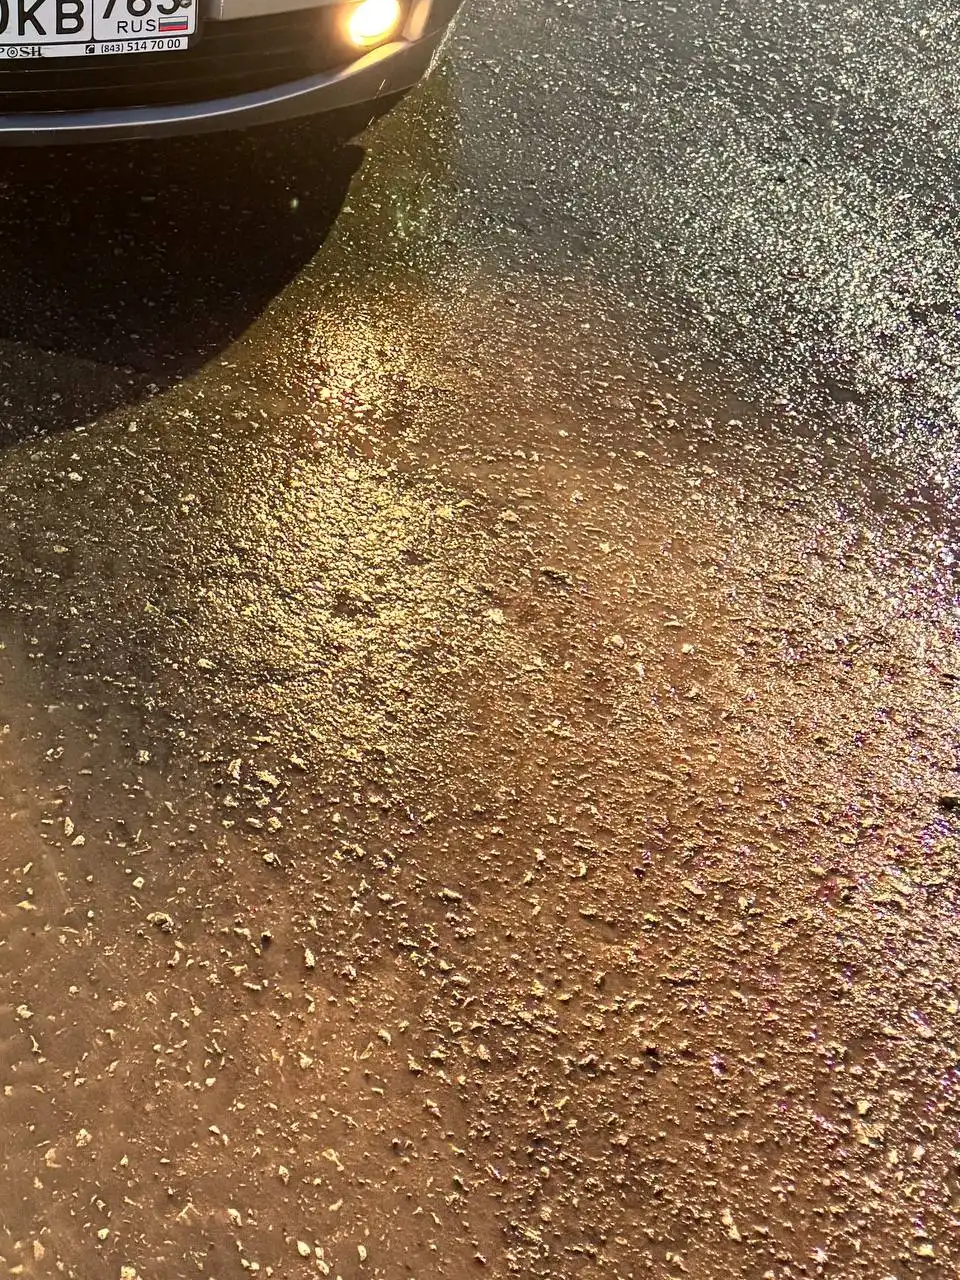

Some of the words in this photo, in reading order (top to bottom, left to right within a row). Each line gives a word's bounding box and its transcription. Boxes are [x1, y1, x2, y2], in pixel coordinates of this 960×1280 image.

[116, 19, 156, 34] RUS
[100, 44, 124, 54] (843)
[126, 41, 147, 52] 514
[151, 40, 164, 50] 70
[167, 38, 181, 49] 00
